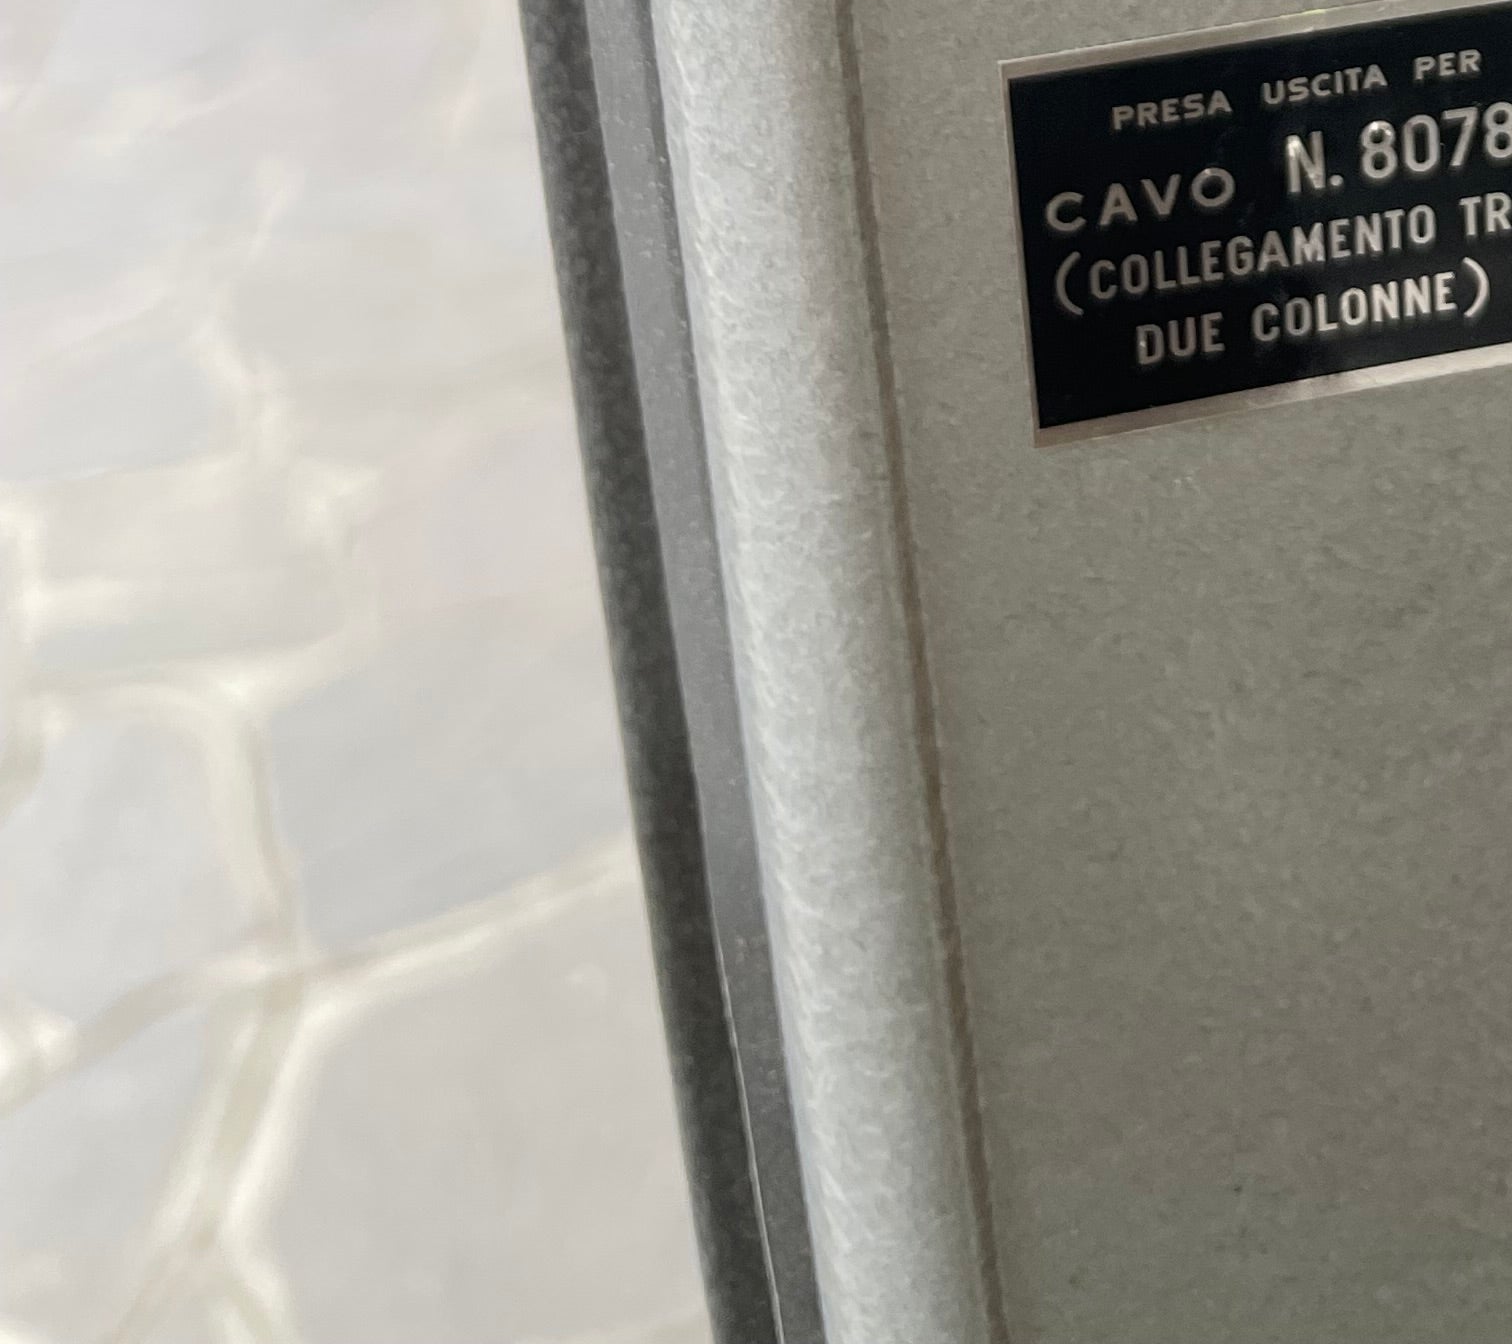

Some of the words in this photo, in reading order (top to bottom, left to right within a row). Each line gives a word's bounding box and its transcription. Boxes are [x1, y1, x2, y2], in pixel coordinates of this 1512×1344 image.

[1112, 90, 1233, 130] PRESA
[1262, 64, 1388, 104] USCITA
[1413, 49, 1481, 80] PER
[1045, 167, 1236, 232] CAVO
[1286, 130, 1343, 193] N.
[1055, 205, 1436, 314] (COLLEGAMENTO
[1136, 312, 1225, 366] DUE
[1251, 257, 1490, 342] COLONNE)
